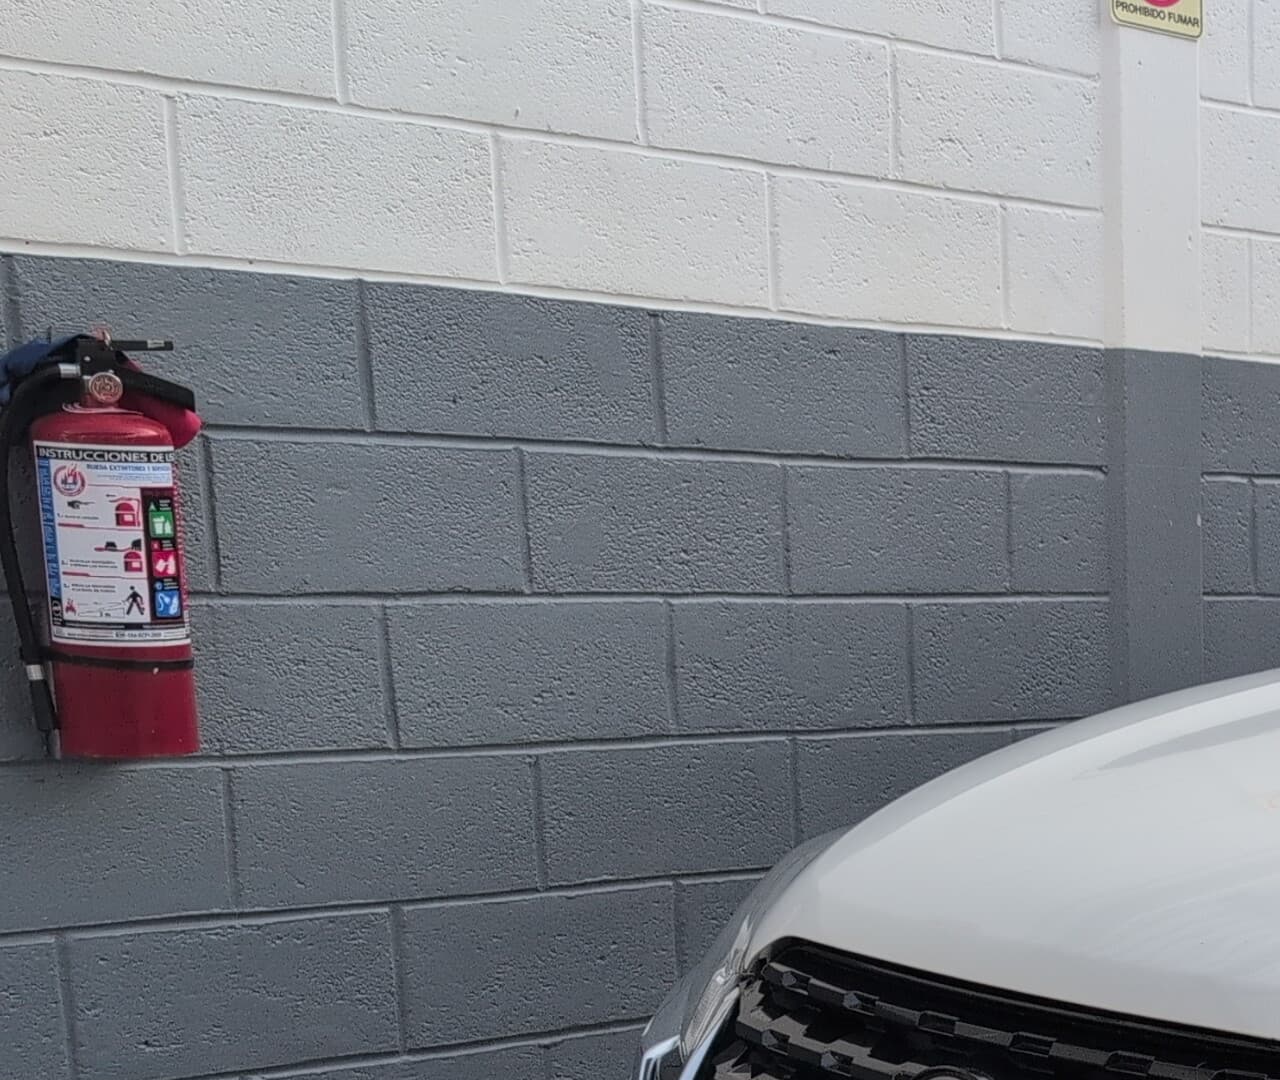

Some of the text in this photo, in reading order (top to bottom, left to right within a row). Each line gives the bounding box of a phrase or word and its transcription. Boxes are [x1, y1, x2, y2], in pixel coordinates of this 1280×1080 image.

[1115, 1, 1200, 28] PROHIBIDO FUMAR
[40, 448, 148, 462] INSTRUCCIONES
[150, 453, 164, 462] DE
